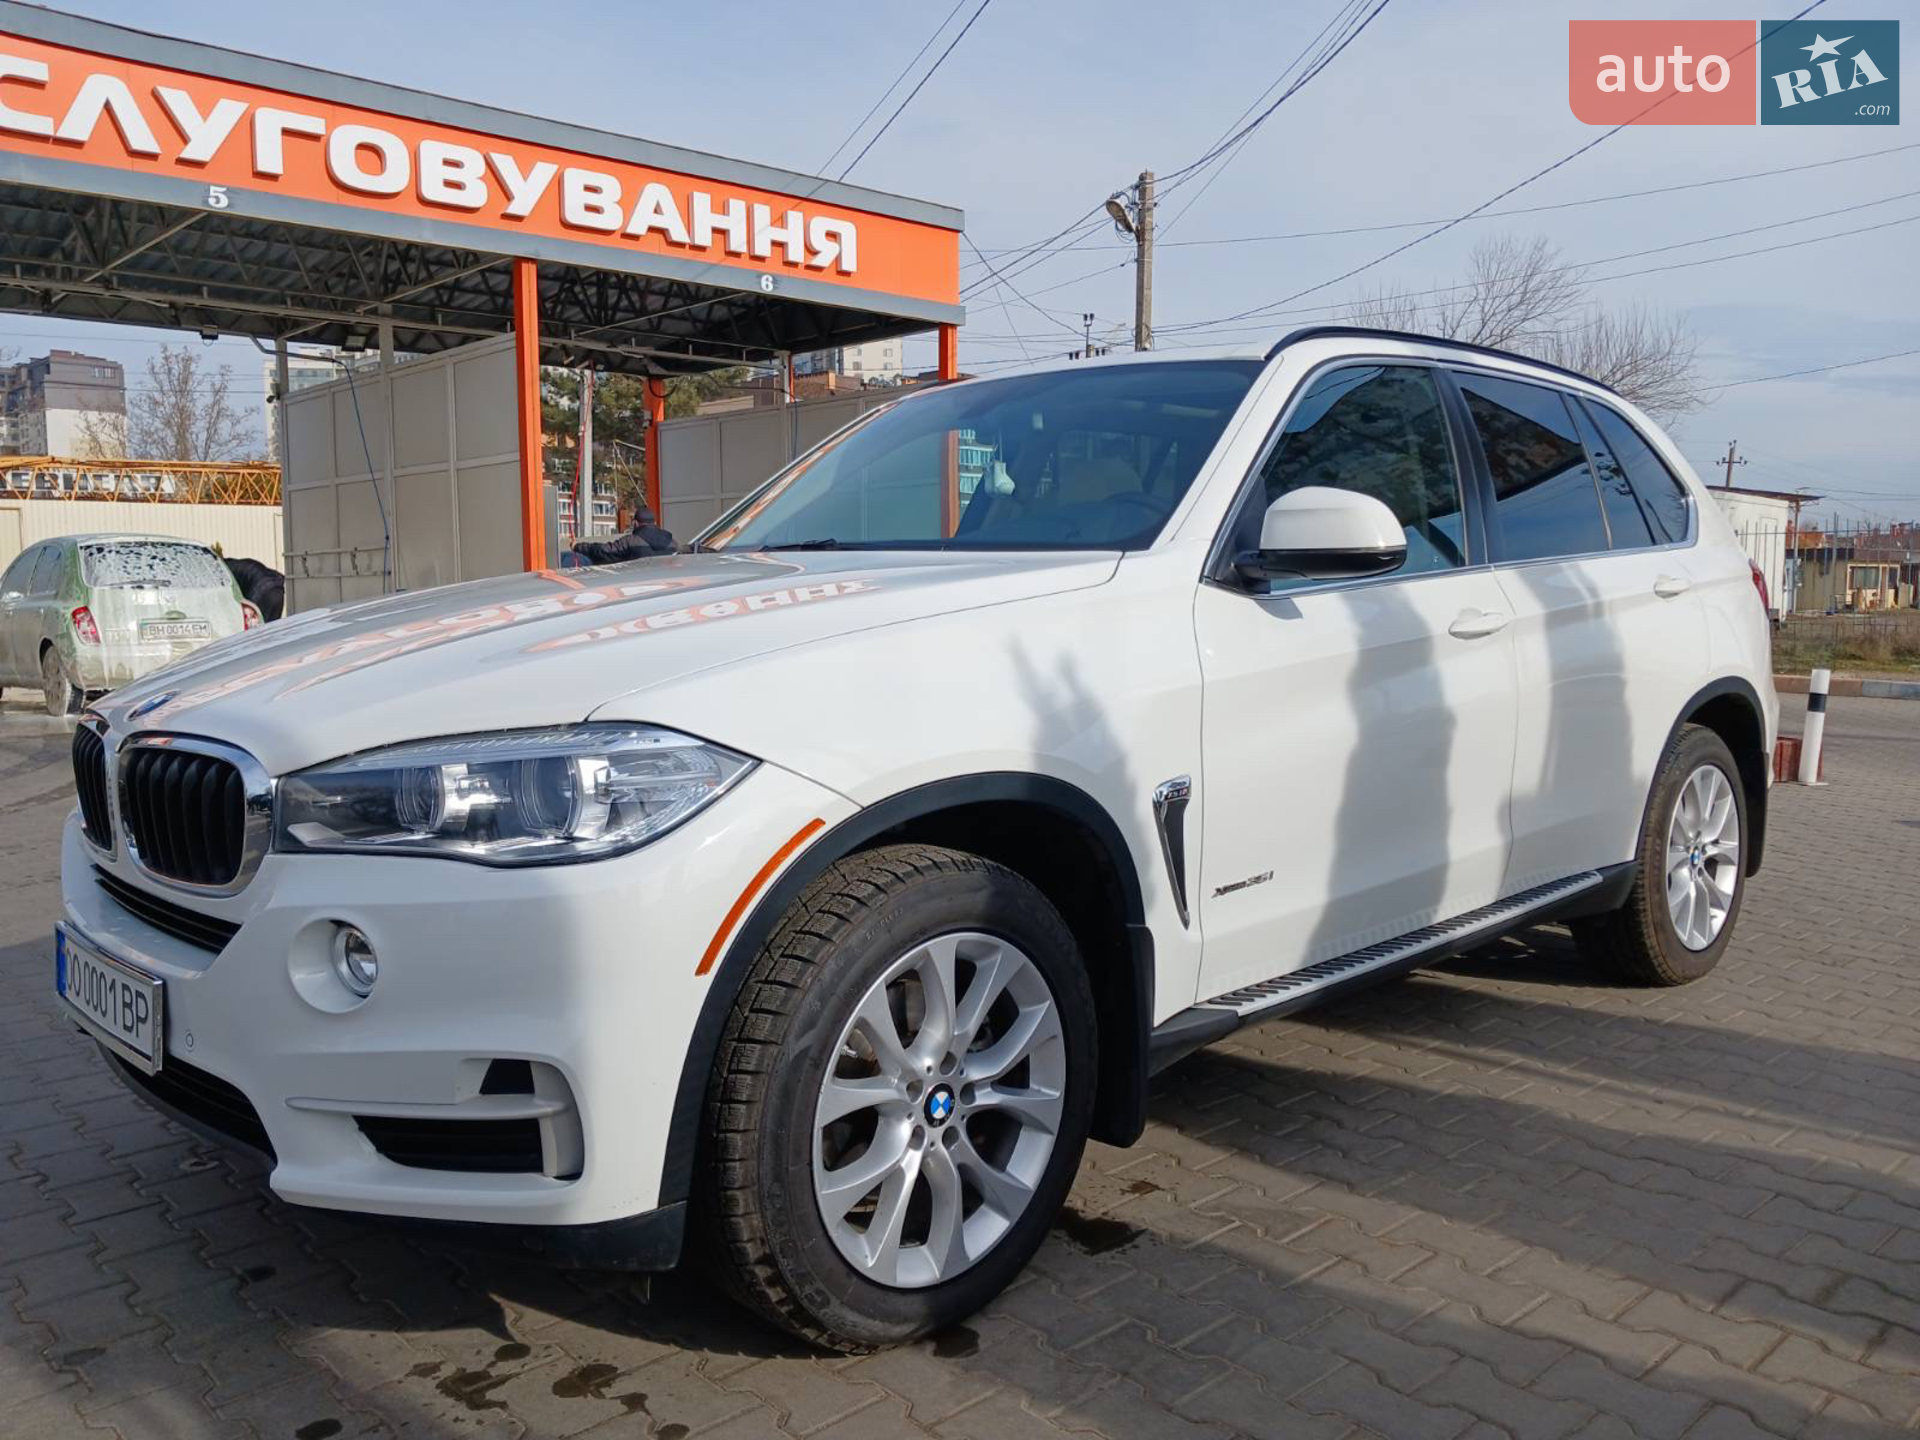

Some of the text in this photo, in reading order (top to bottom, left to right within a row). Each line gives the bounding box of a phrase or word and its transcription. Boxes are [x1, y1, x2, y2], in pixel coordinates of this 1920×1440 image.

[208, 186, 229, 208] 5
[760, 275, 774, 292] 6
[121, 982, 149, 1038] BP
